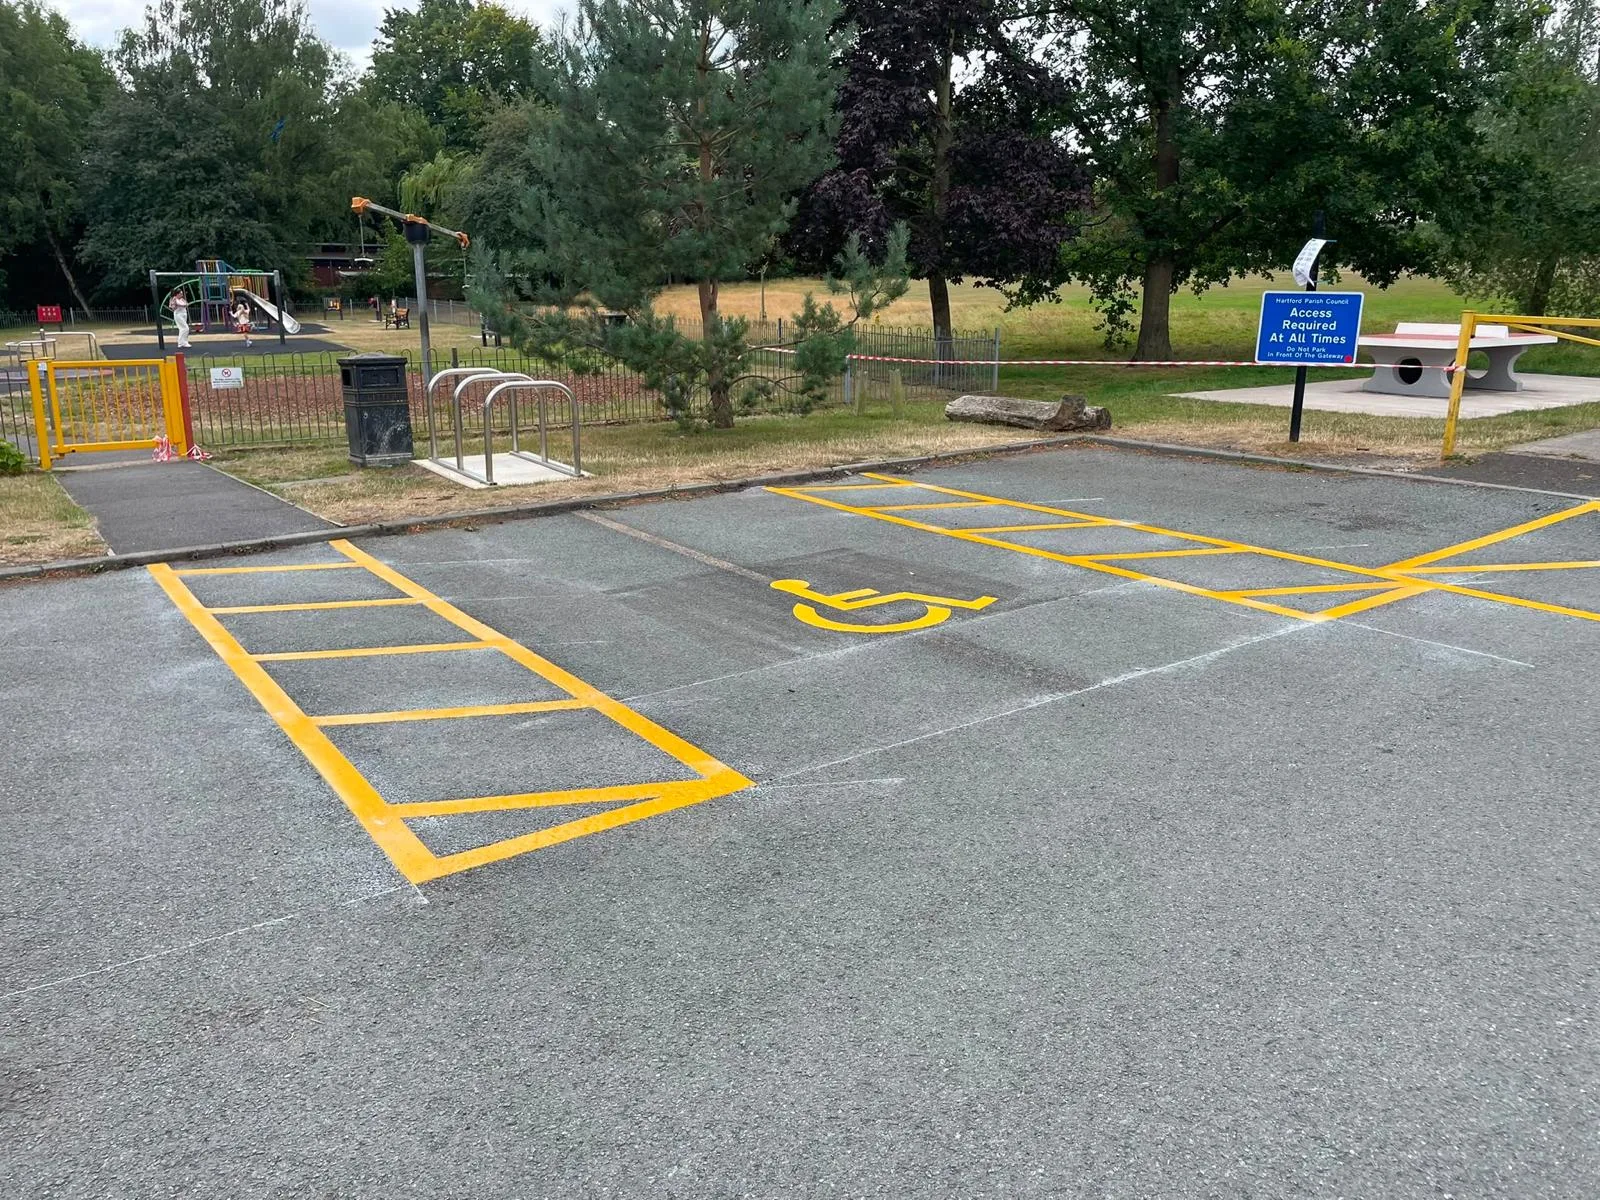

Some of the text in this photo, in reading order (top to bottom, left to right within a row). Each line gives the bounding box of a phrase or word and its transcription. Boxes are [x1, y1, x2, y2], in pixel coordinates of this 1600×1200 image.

[1290, 308, 1332, 317] Access
[1282, 320, 1336, 331] Required
[1270, 333, 1346, 344] At All Times
